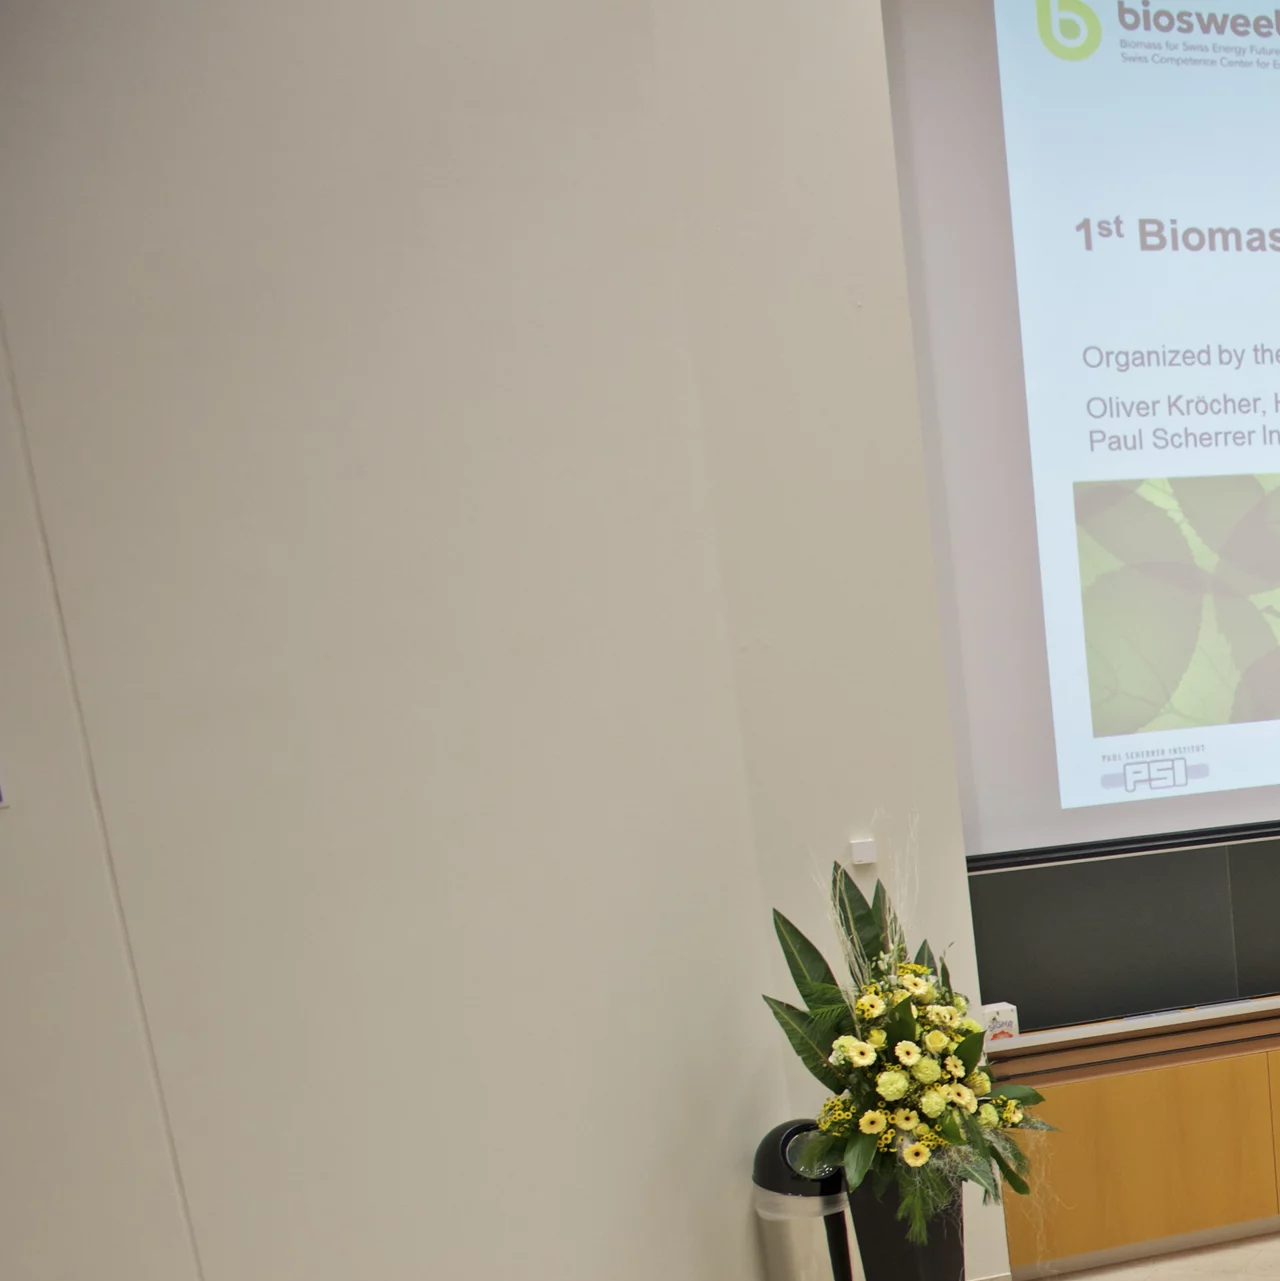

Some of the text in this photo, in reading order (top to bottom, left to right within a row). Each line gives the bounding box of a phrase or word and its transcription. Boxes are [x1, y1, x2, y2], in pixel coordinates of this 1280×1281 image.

[1120, 39, 1280, 57] Biomass for Swiss Energy Future
[1121, 53, 1149, 63] Swiss
[1151, 54, 1217, 68] Competence
[1220, 57, 1254, 69] Center
[1256, 58, 1270, 69] for
[1082, 345, 1211, 373] Organized
[1218, 344, 1245, 370] by
[1086, 397, 1161, 419] Oliver
[1167, 394, 1267, 417] Kröcher,
[1089, 429, 1143, 452] Paul
[1152, 427, 1255, 450] Scherrer
[1123, 757, 1189, 793] PSI
